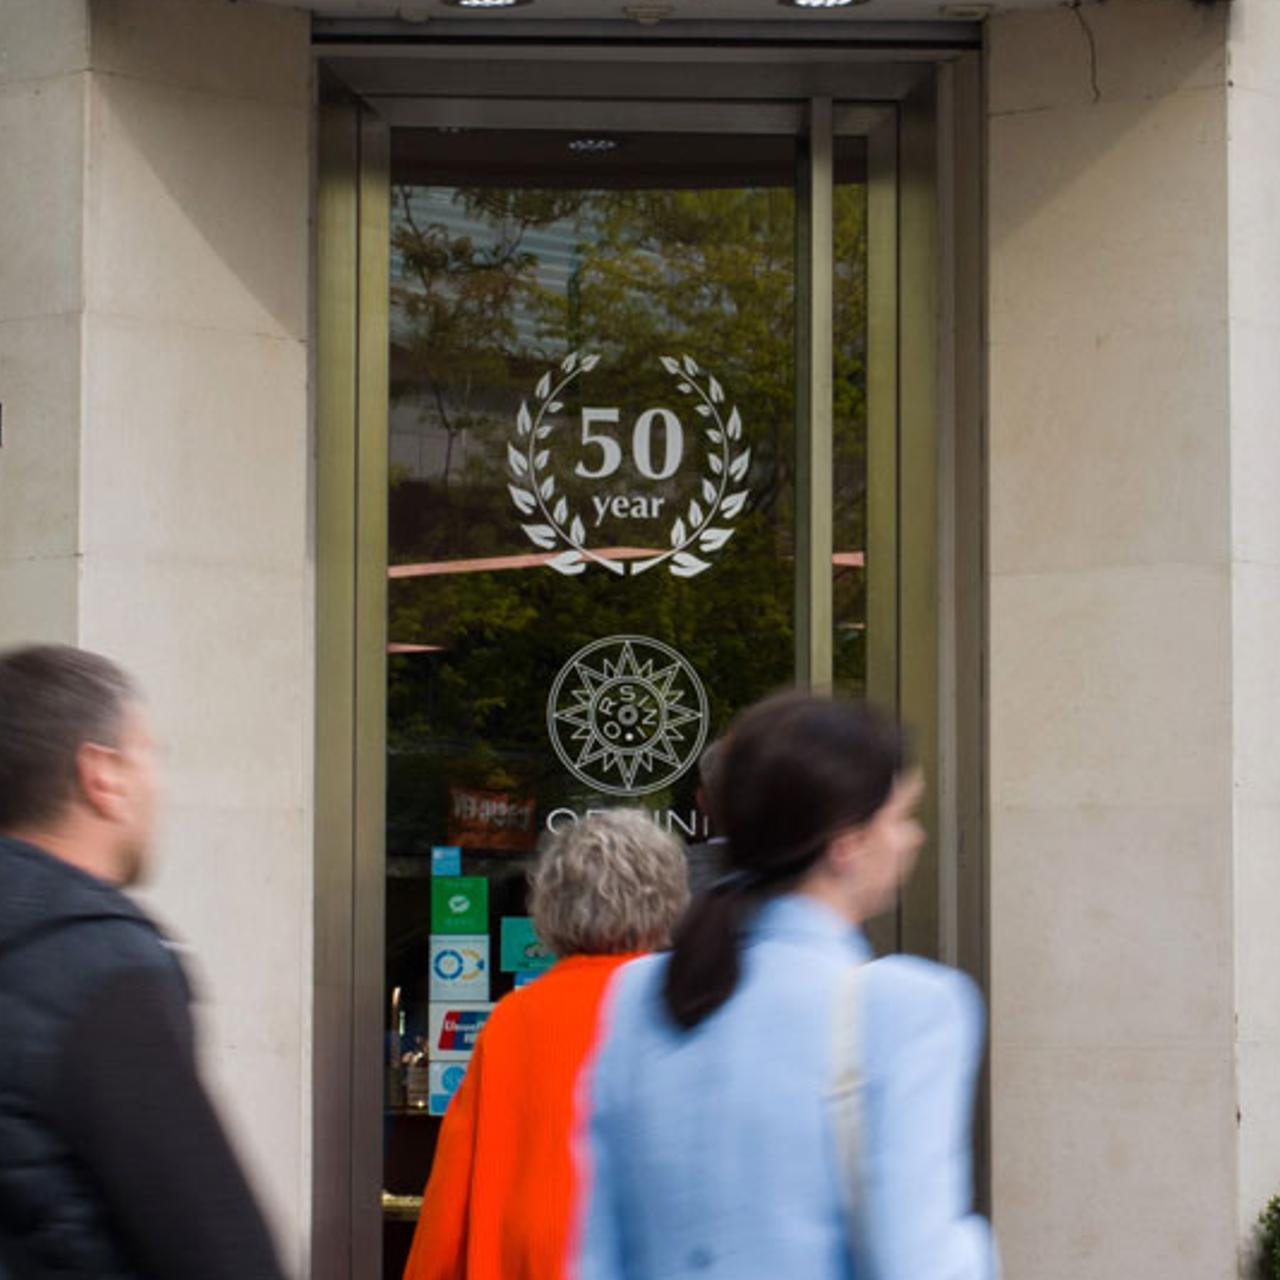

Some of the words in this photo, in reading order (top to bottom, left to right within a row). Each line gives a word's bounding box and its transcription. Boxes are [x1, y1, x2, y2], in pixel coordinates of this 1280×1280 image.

[575, 407, 683, 480] 50
[593, 494, 665, 526] year
[546, 808, 708, 836] OINI
